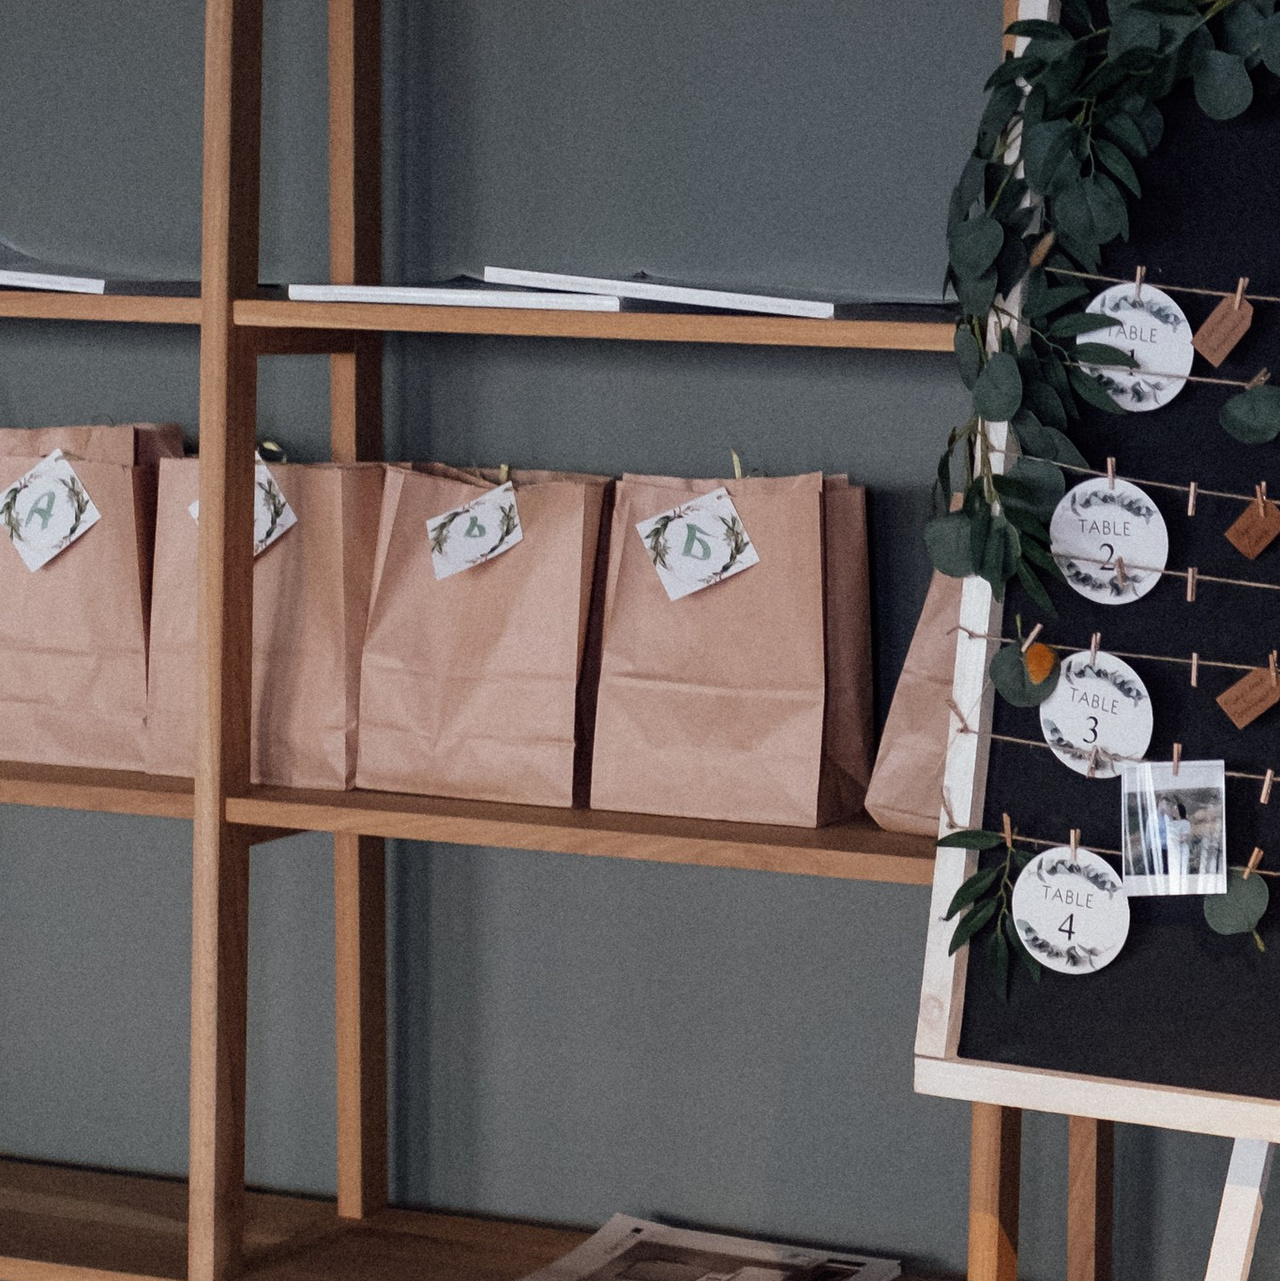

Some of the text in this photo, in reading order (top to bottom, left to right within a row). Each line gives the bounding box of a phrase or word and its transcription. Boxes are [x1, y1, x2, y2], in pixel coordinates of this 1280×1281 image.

[1077, 518, 1132, 537] TABLE
[1099, 542, 1116, 571] 2
[1069, 686, 1120, 716] TABLE
[1082, 715, 1099, 744] 3
[1042, 884, 1094, 910] TABLE
[1057, 912, 1076, 941] 4
